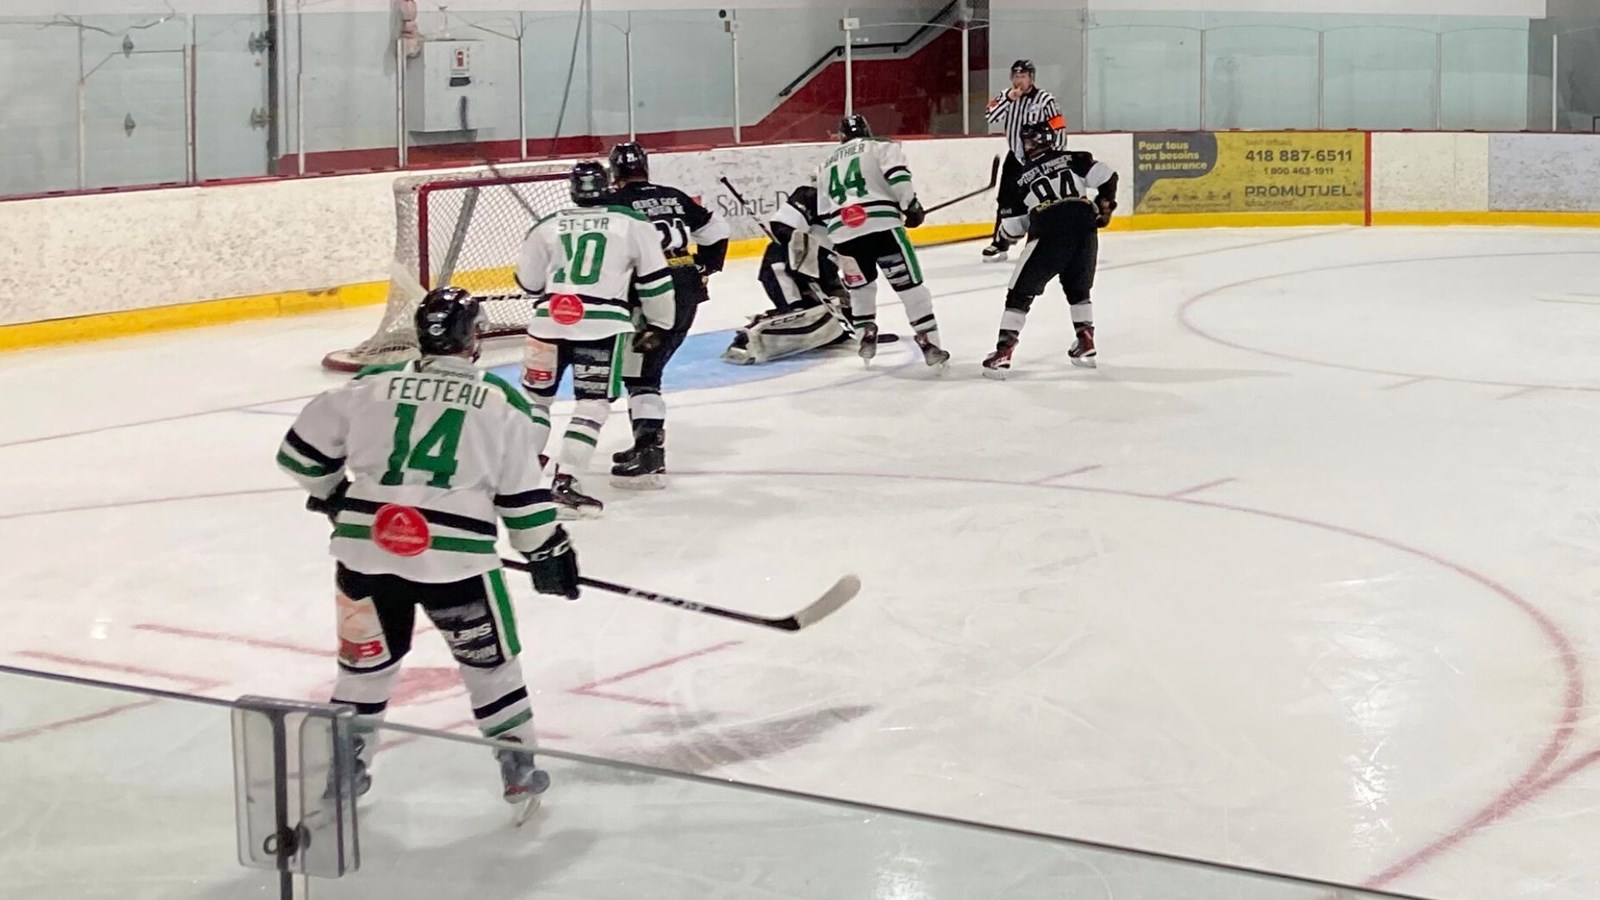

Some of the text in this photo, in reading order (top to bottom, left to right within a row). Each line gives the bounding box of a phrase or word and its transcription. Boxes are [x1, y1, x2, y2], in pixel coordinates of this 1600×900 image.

[1138, 141, 1189, 150] Pour tous
[1159, 150, 1200, 160] besoins
[1244, 149, 1352, 162] 418 887-6511
[1138, 162, 1208, 171] en assurance
[1270, 167, 1290, 175] 800
[828, 157, 869, 205] 44
[1244, 185, 1353, 198] PROMUTUEL
[558, 217, 610, 232] ST-CYR
[553, 231, 608, 286] 10
[387, 376, 490, 410] FECTEAU
[379, 402, 468, 490] 14
